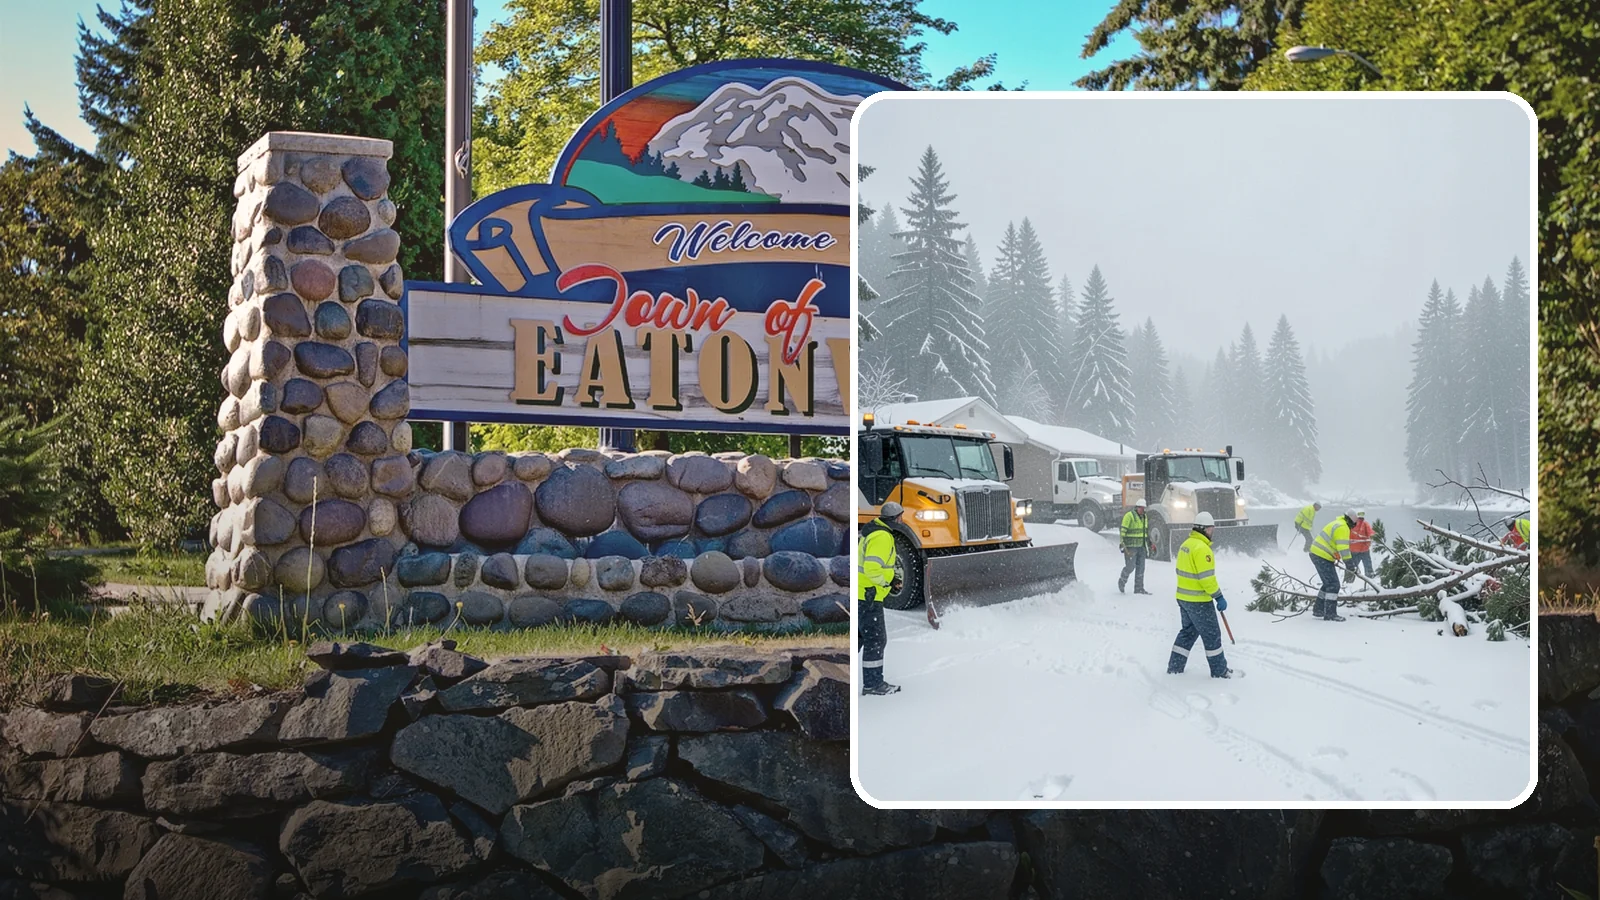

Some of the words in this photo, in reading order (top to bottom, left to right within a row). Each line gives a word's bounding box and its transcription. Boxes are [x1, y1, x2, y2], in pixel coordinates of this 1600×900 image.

[653, 220, 837, 263] Welcome
[556, 263, 737, 337] Town
[765, 278, 826, 365] of
